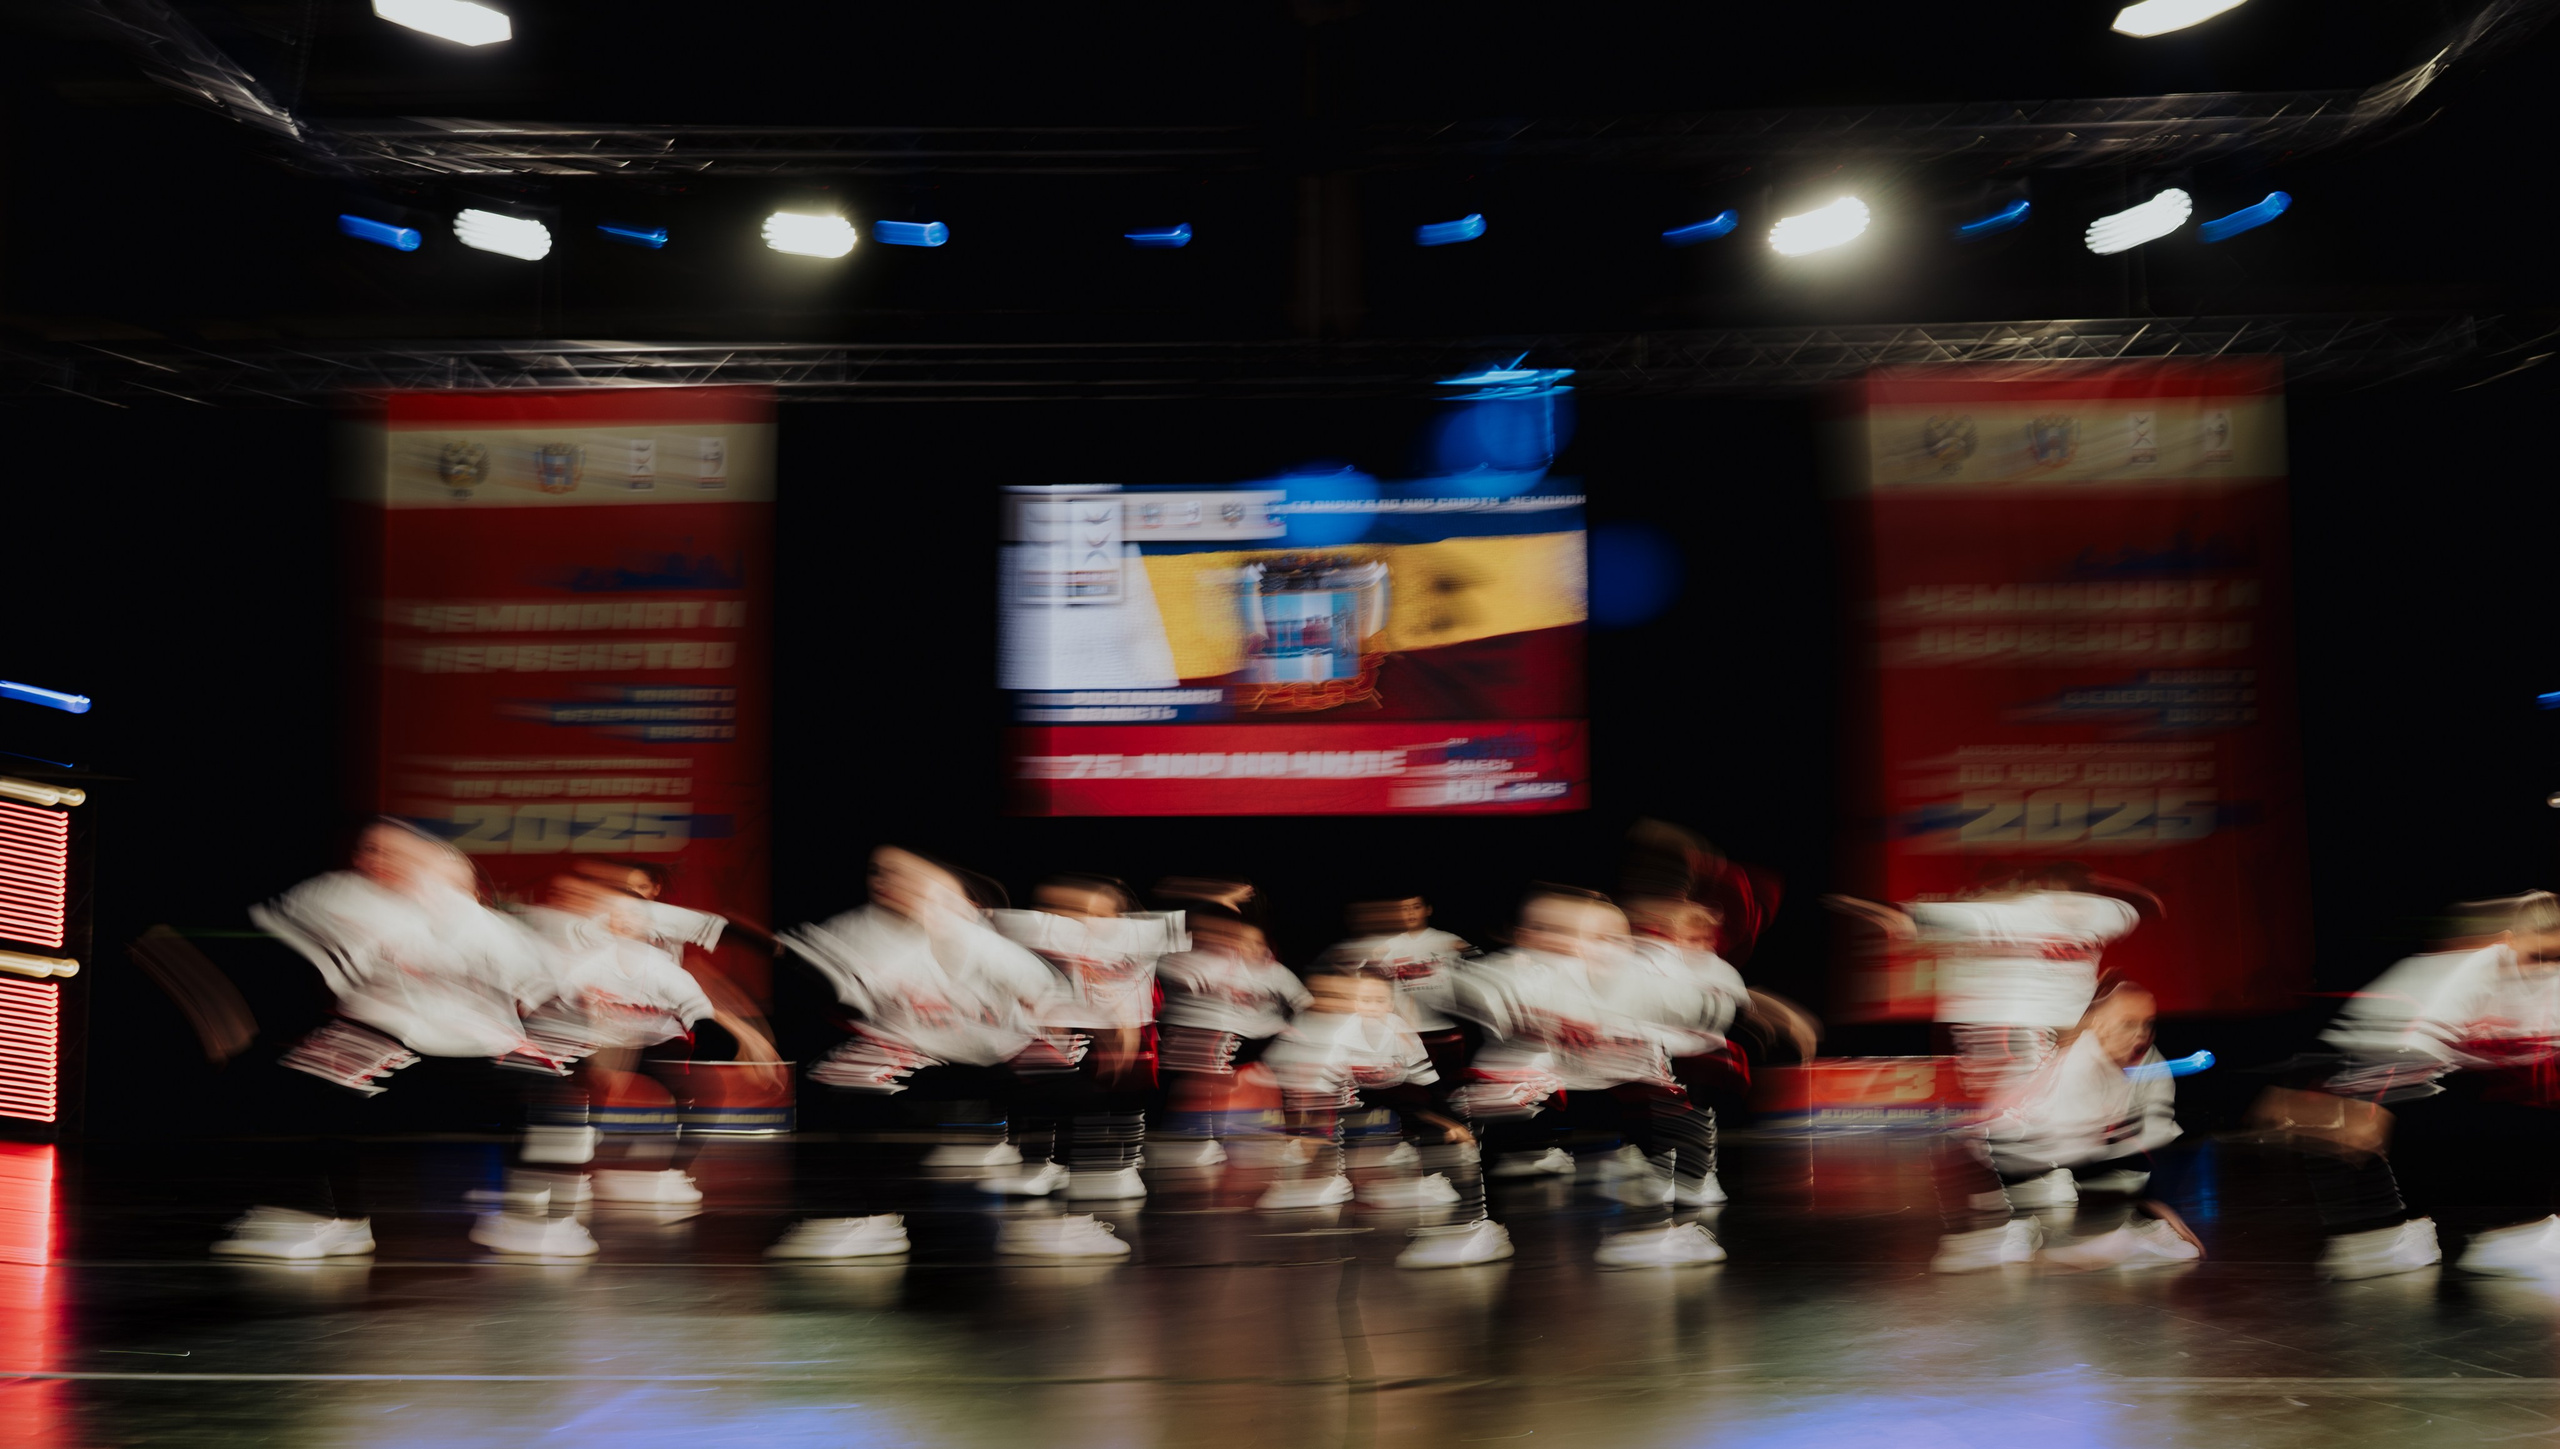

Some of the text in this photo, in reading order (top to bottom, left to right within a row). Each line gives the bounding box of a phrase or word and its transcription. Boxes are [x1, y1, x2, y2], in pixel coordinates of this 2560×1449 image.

[1437, 497, 1500, 506] СПОРТУ
[1905, 579, 2263, 612] ЧЕМПИОНАТ И
[411, 601, 748, 633] ЧЕМПИОНАТ И
[1918, 622, 2255, 653] ПЕРВЕНСТВО
[421, 642, 737, 674] ПЕРВЕНСТВО
[1142, 753, 1226, 776] ЧИР
[1231, 752, 1289, 775] НА
[1447, 759, 1514, 771] ЗДЕСЬ
[1959, 764, 2005, 782] ПО
[2083, 761, 2216, 781] СПОРТУ
[569, 777, 693, 797] СПОРТУ
[1515, 782, 1568, 795] 2025
[453, 802, 694, 854] 2025
[1960, 788, 2219, 841] 2025
